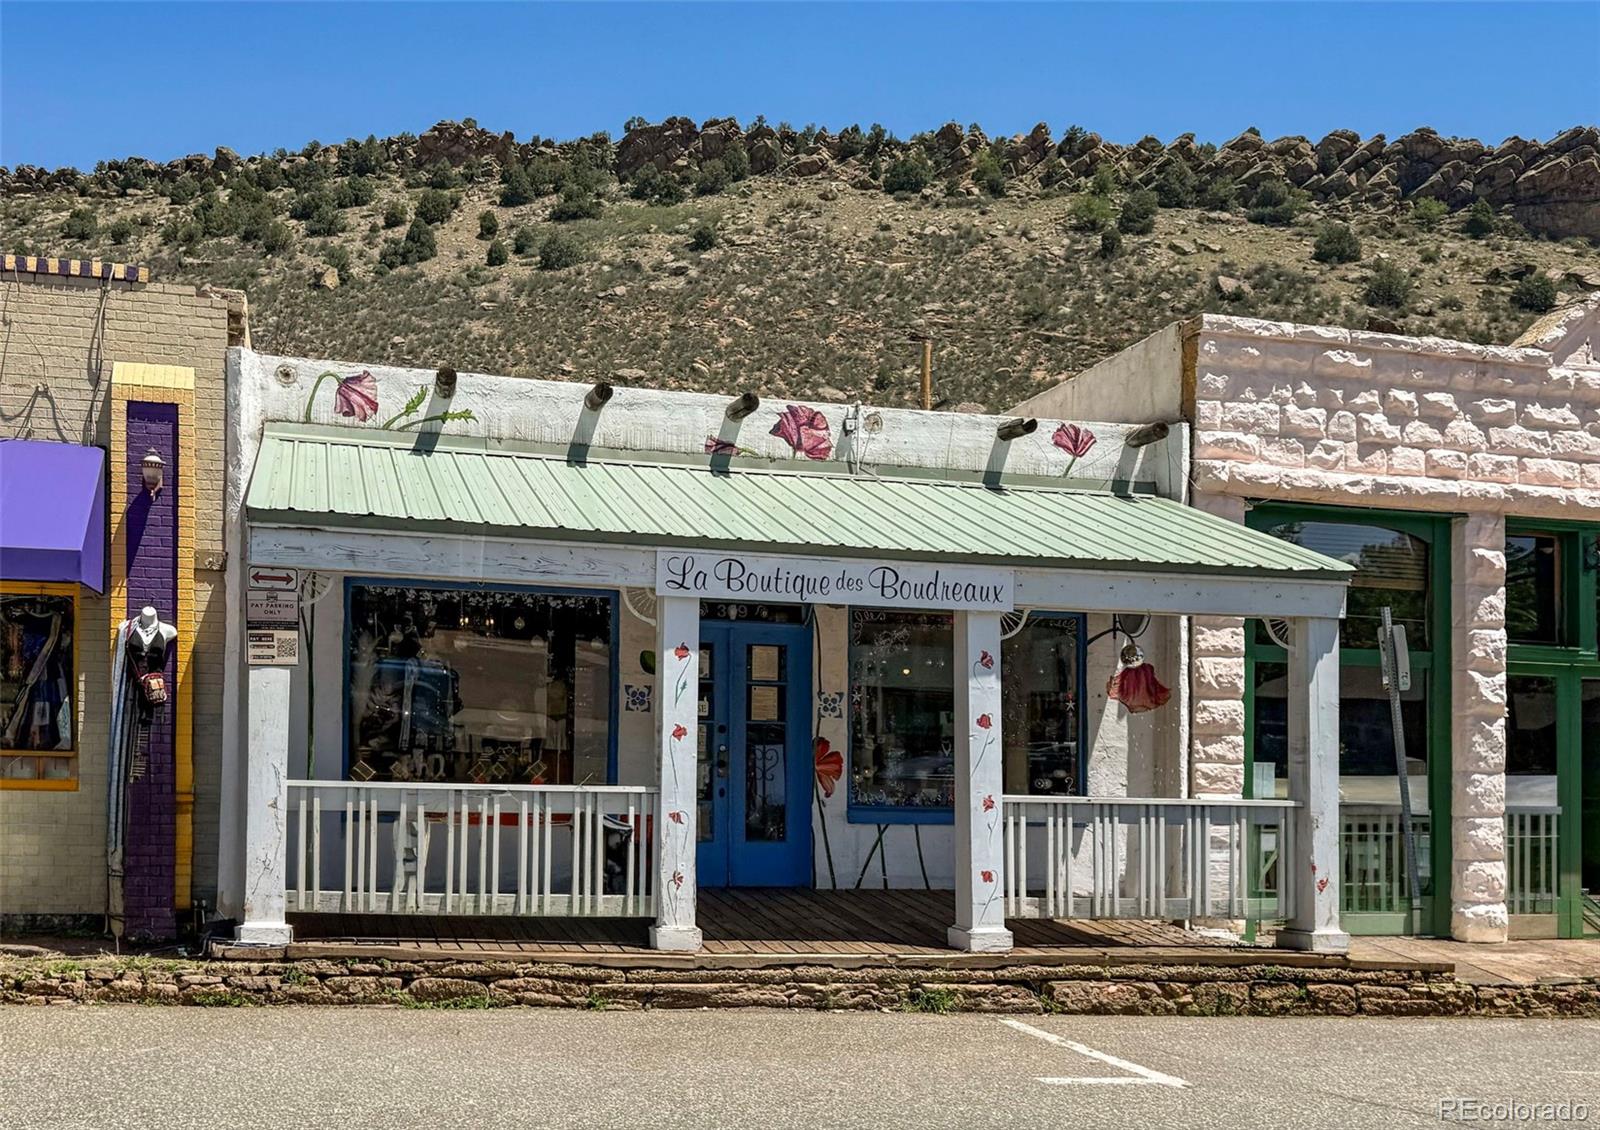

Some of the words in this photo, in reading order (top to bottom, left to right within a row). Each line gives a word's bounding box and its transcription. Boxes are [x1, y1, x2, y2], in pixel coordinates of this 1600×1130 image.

[666, 555, 708, 591] La
[714, 558, 831, 601] Boutique
[835, 569, 863, 592] des
[868, 565, 1004, 603] Boudreaux
